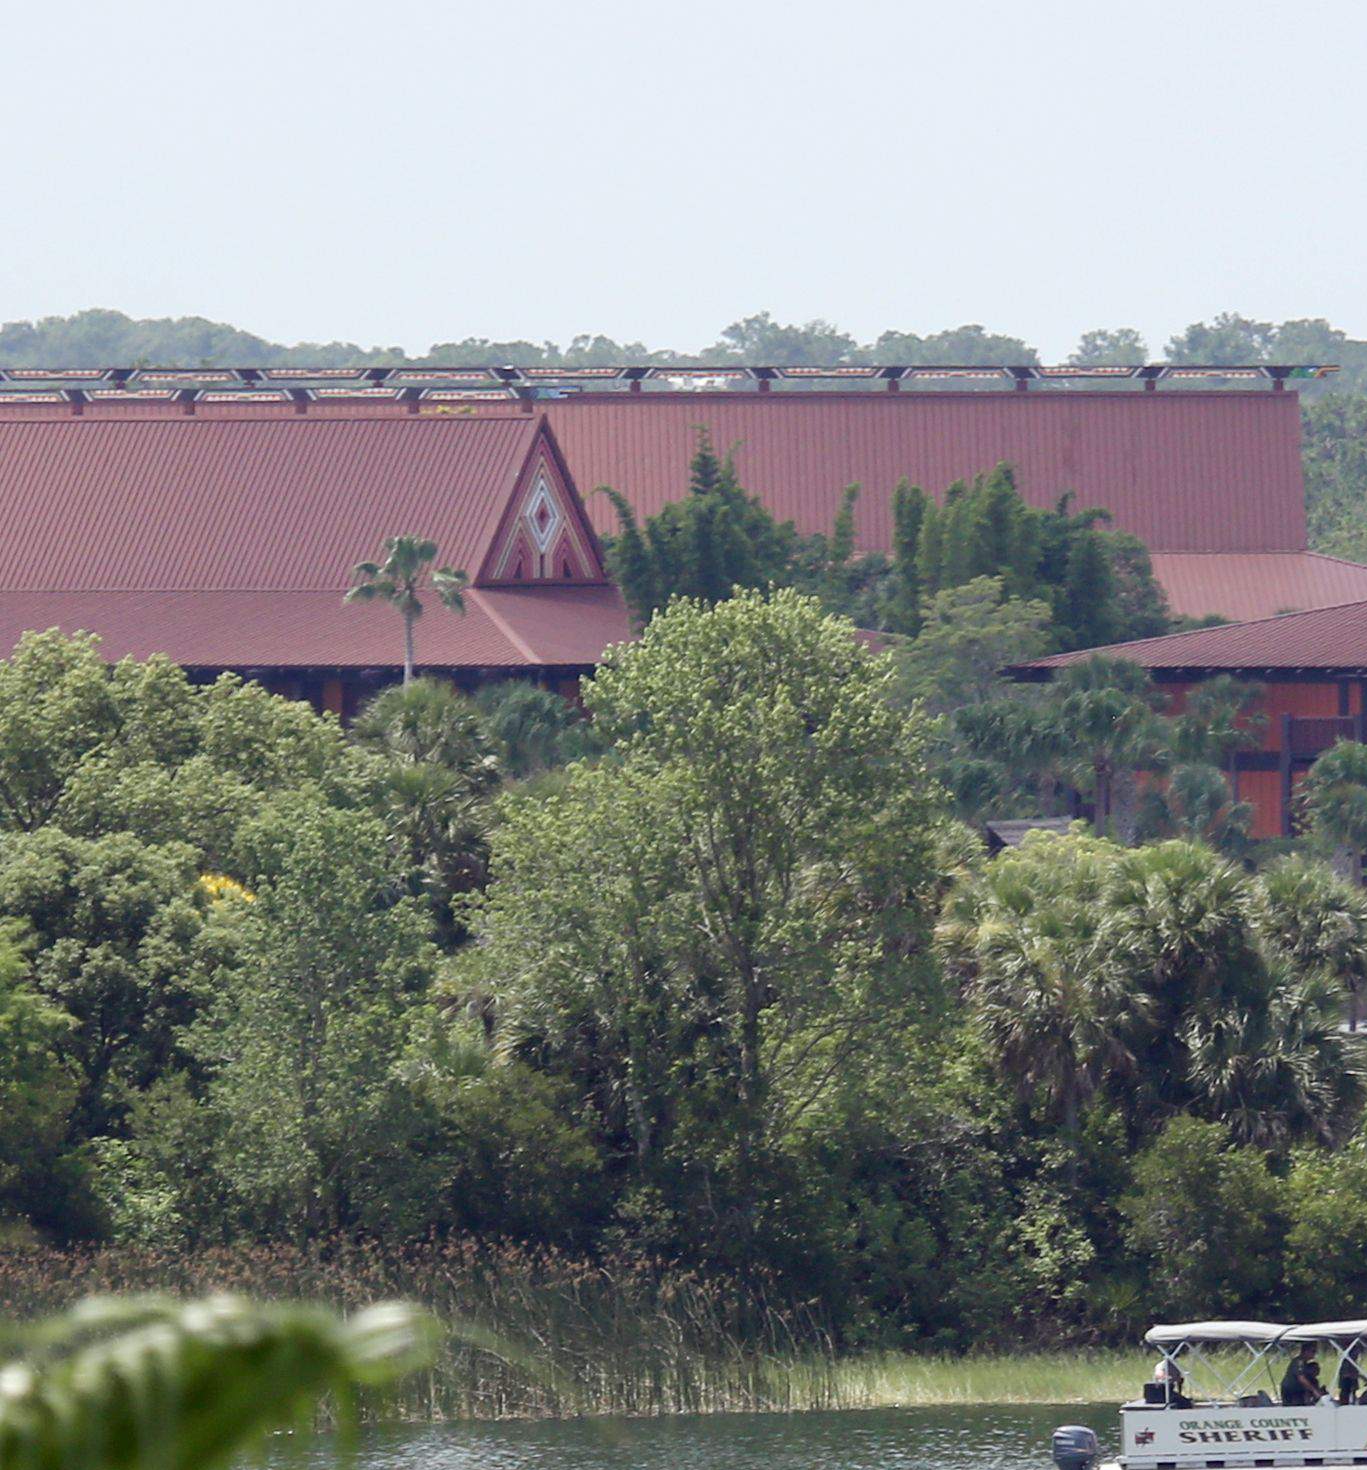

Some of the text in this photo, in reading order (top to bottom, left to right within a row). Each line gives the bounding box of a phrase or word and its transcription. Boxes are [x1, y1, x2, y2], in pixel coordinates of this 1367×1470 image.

[1179, 1417, 1309, 1430] ORANGE COUNTY
[1178, 1429, 1313, 1443] SHERIFF
